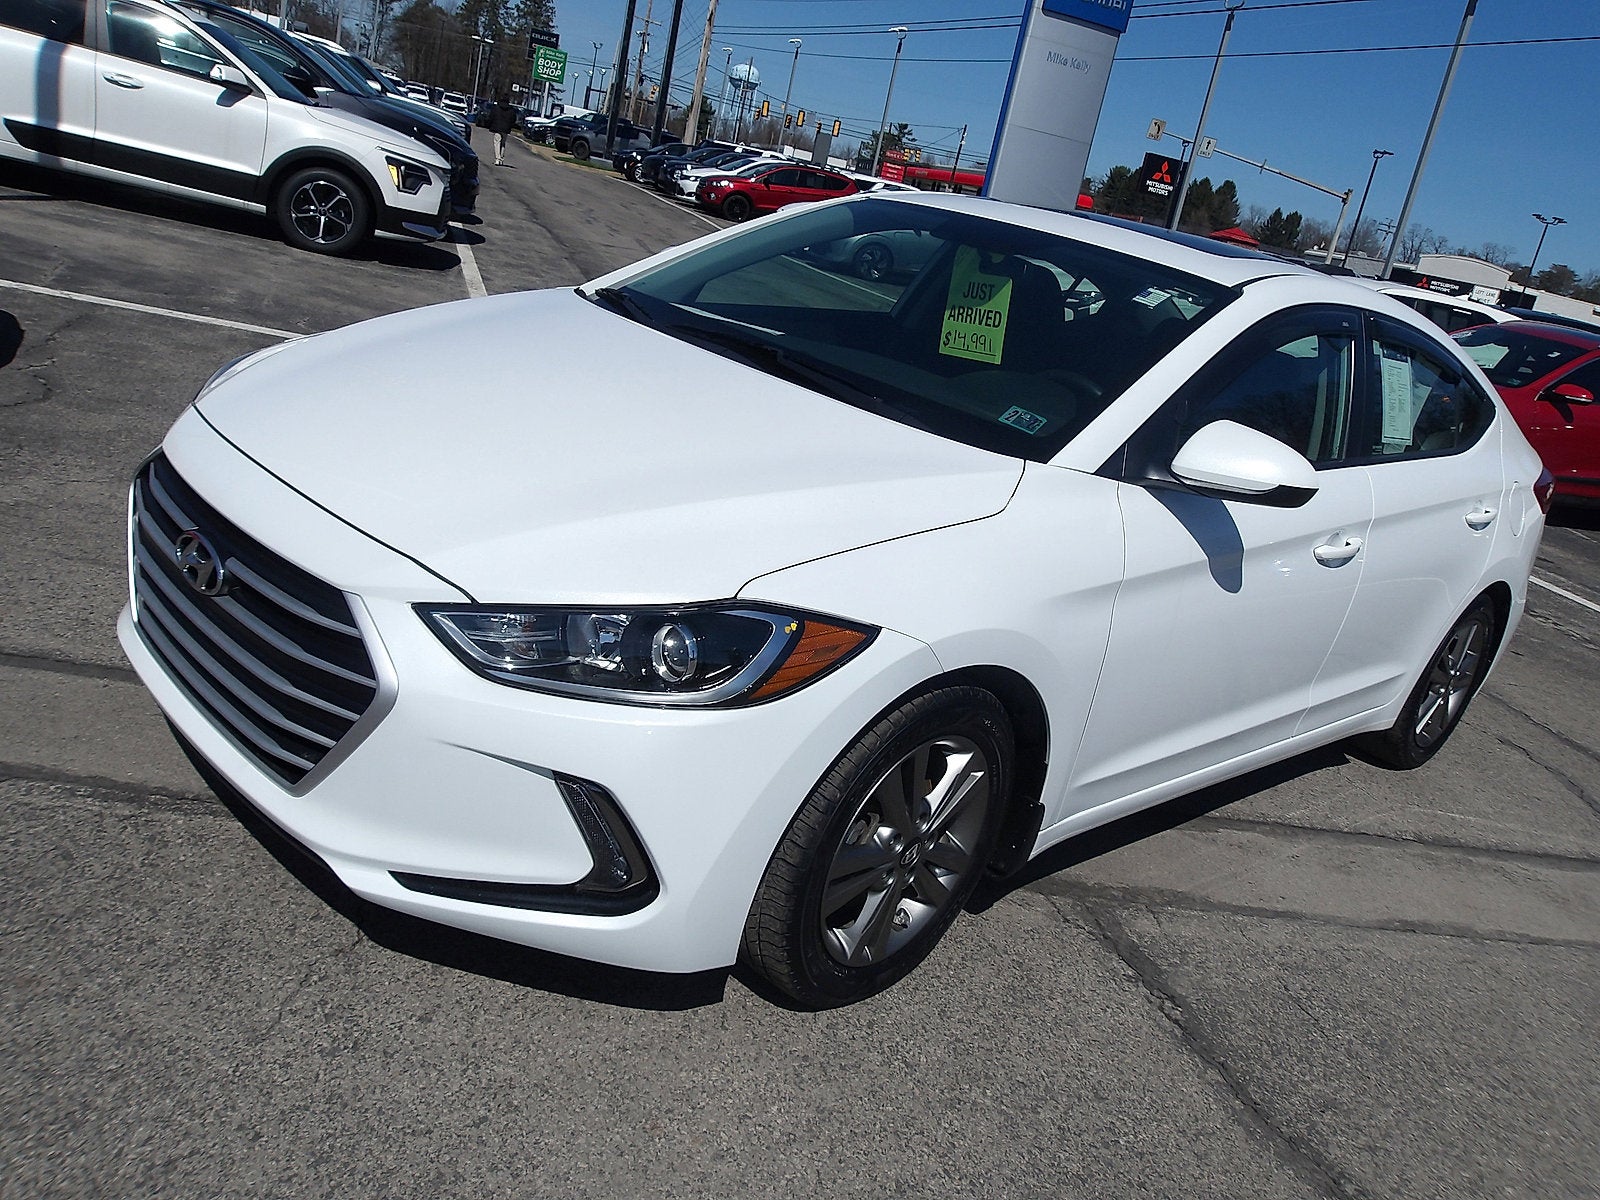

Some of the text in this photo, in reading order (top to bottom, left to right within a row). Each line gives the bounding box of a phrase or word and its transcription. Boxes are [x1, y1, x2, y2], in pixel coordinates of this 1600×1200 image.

[538, 58, 563, 69] BODY
[1046, 50, 1092, 75] Mike Kelly
[537, 66, 561, 77] SHOP
[1146, 180, 1174, 192] MITSUBISHI
[1148, 186, 1169, 196] MOTORS
[1430, 280, 1460, 290] MITSUBISHI
[963, 282, 995, 301] JUST
[948, 304, 1002, 328] ARRIVED
[943, 330, 992, 352] $14,991
